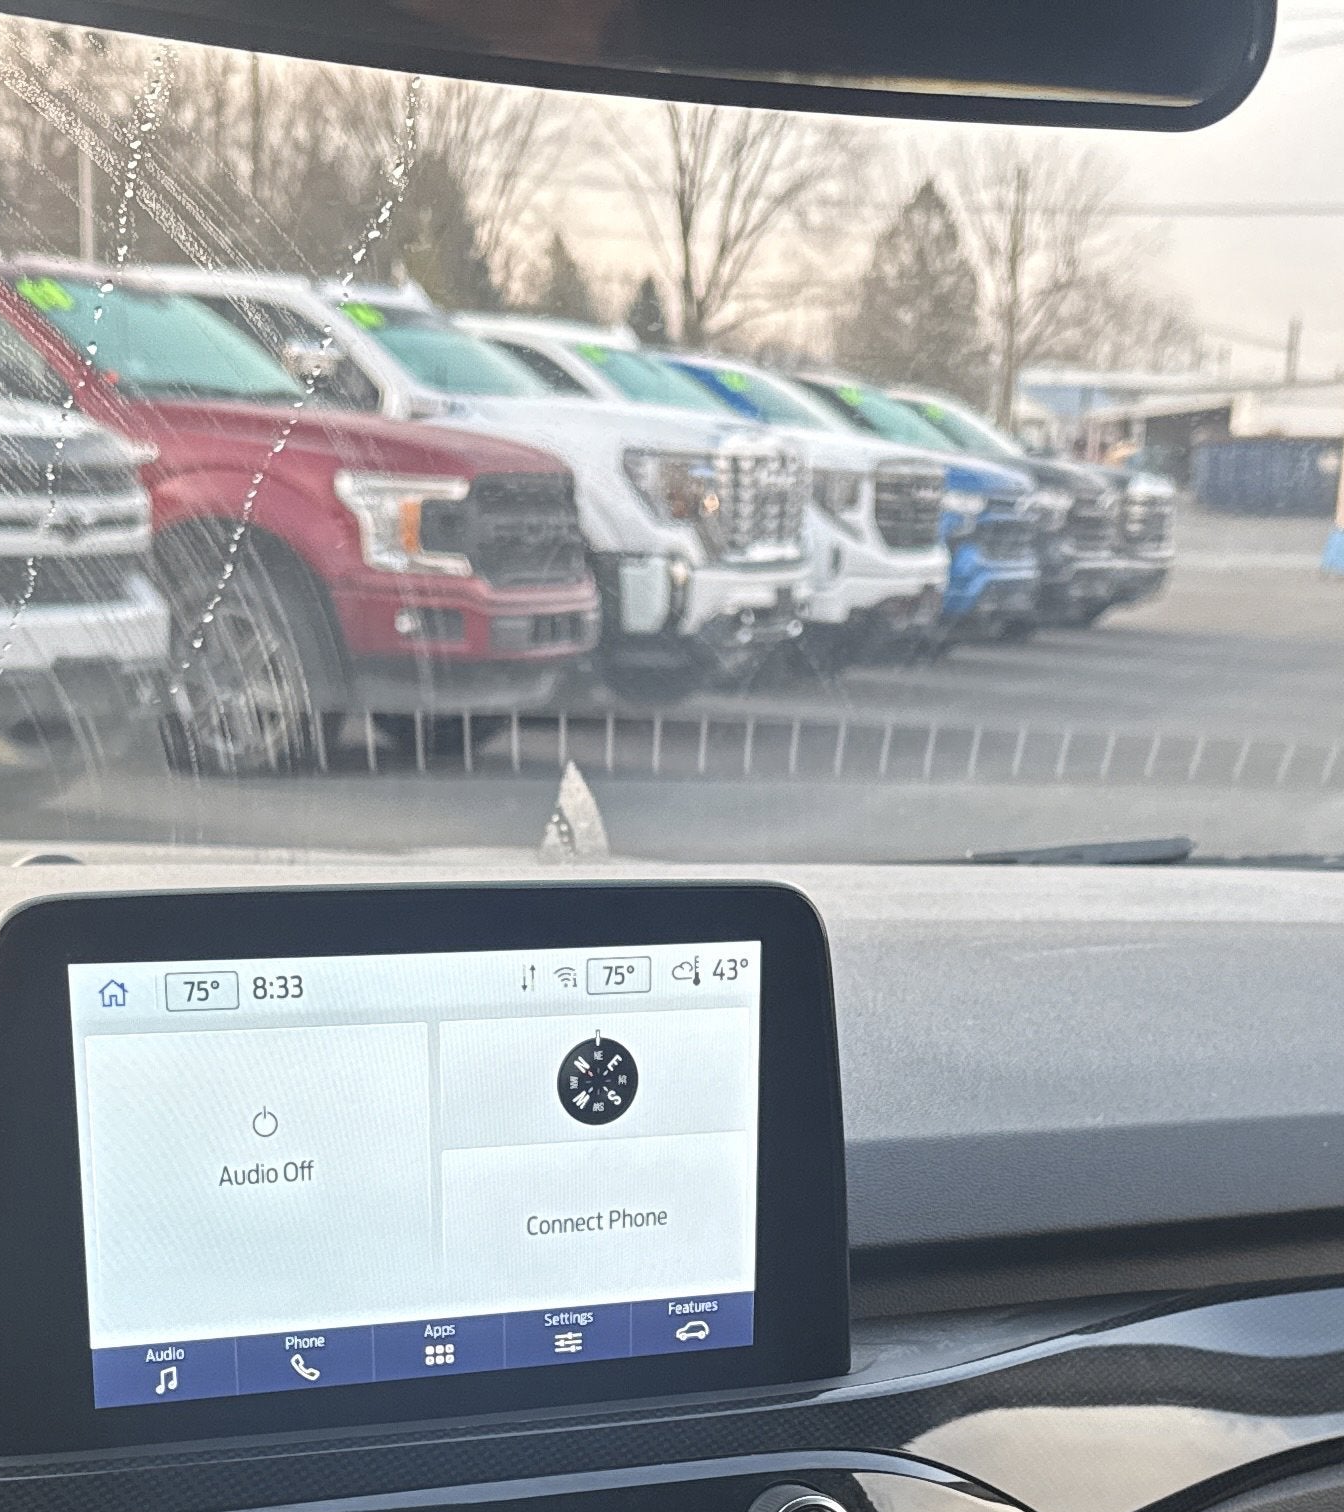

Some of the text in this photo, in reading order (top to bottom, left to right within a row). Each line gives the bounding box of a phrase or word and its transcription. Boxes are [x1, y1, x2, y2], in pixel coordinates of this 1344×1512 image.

[602, 965, 635, 986] 75°
[712, 958, 749, 981] 43°
[183, 980, 220, 1002] 75°
[252, 975, 304, 1000] 8:33
[573, 1055, 590, 1074] N
[607, 1054, 623, 1072] E
[607, 1089, 622, 1106] S
[218, 1160, 315, 1187] Audio Off
[526, 1207, 668, 1236] Connect Phone
[668, 1299, 719, 1316] Features
[544, 1310, 594, 1328] Settings
[424, 1323, 456, 1339] Apps
[285, 1334, 326, 1351] Phone
[145, 1346, 185, 1363] Audio
